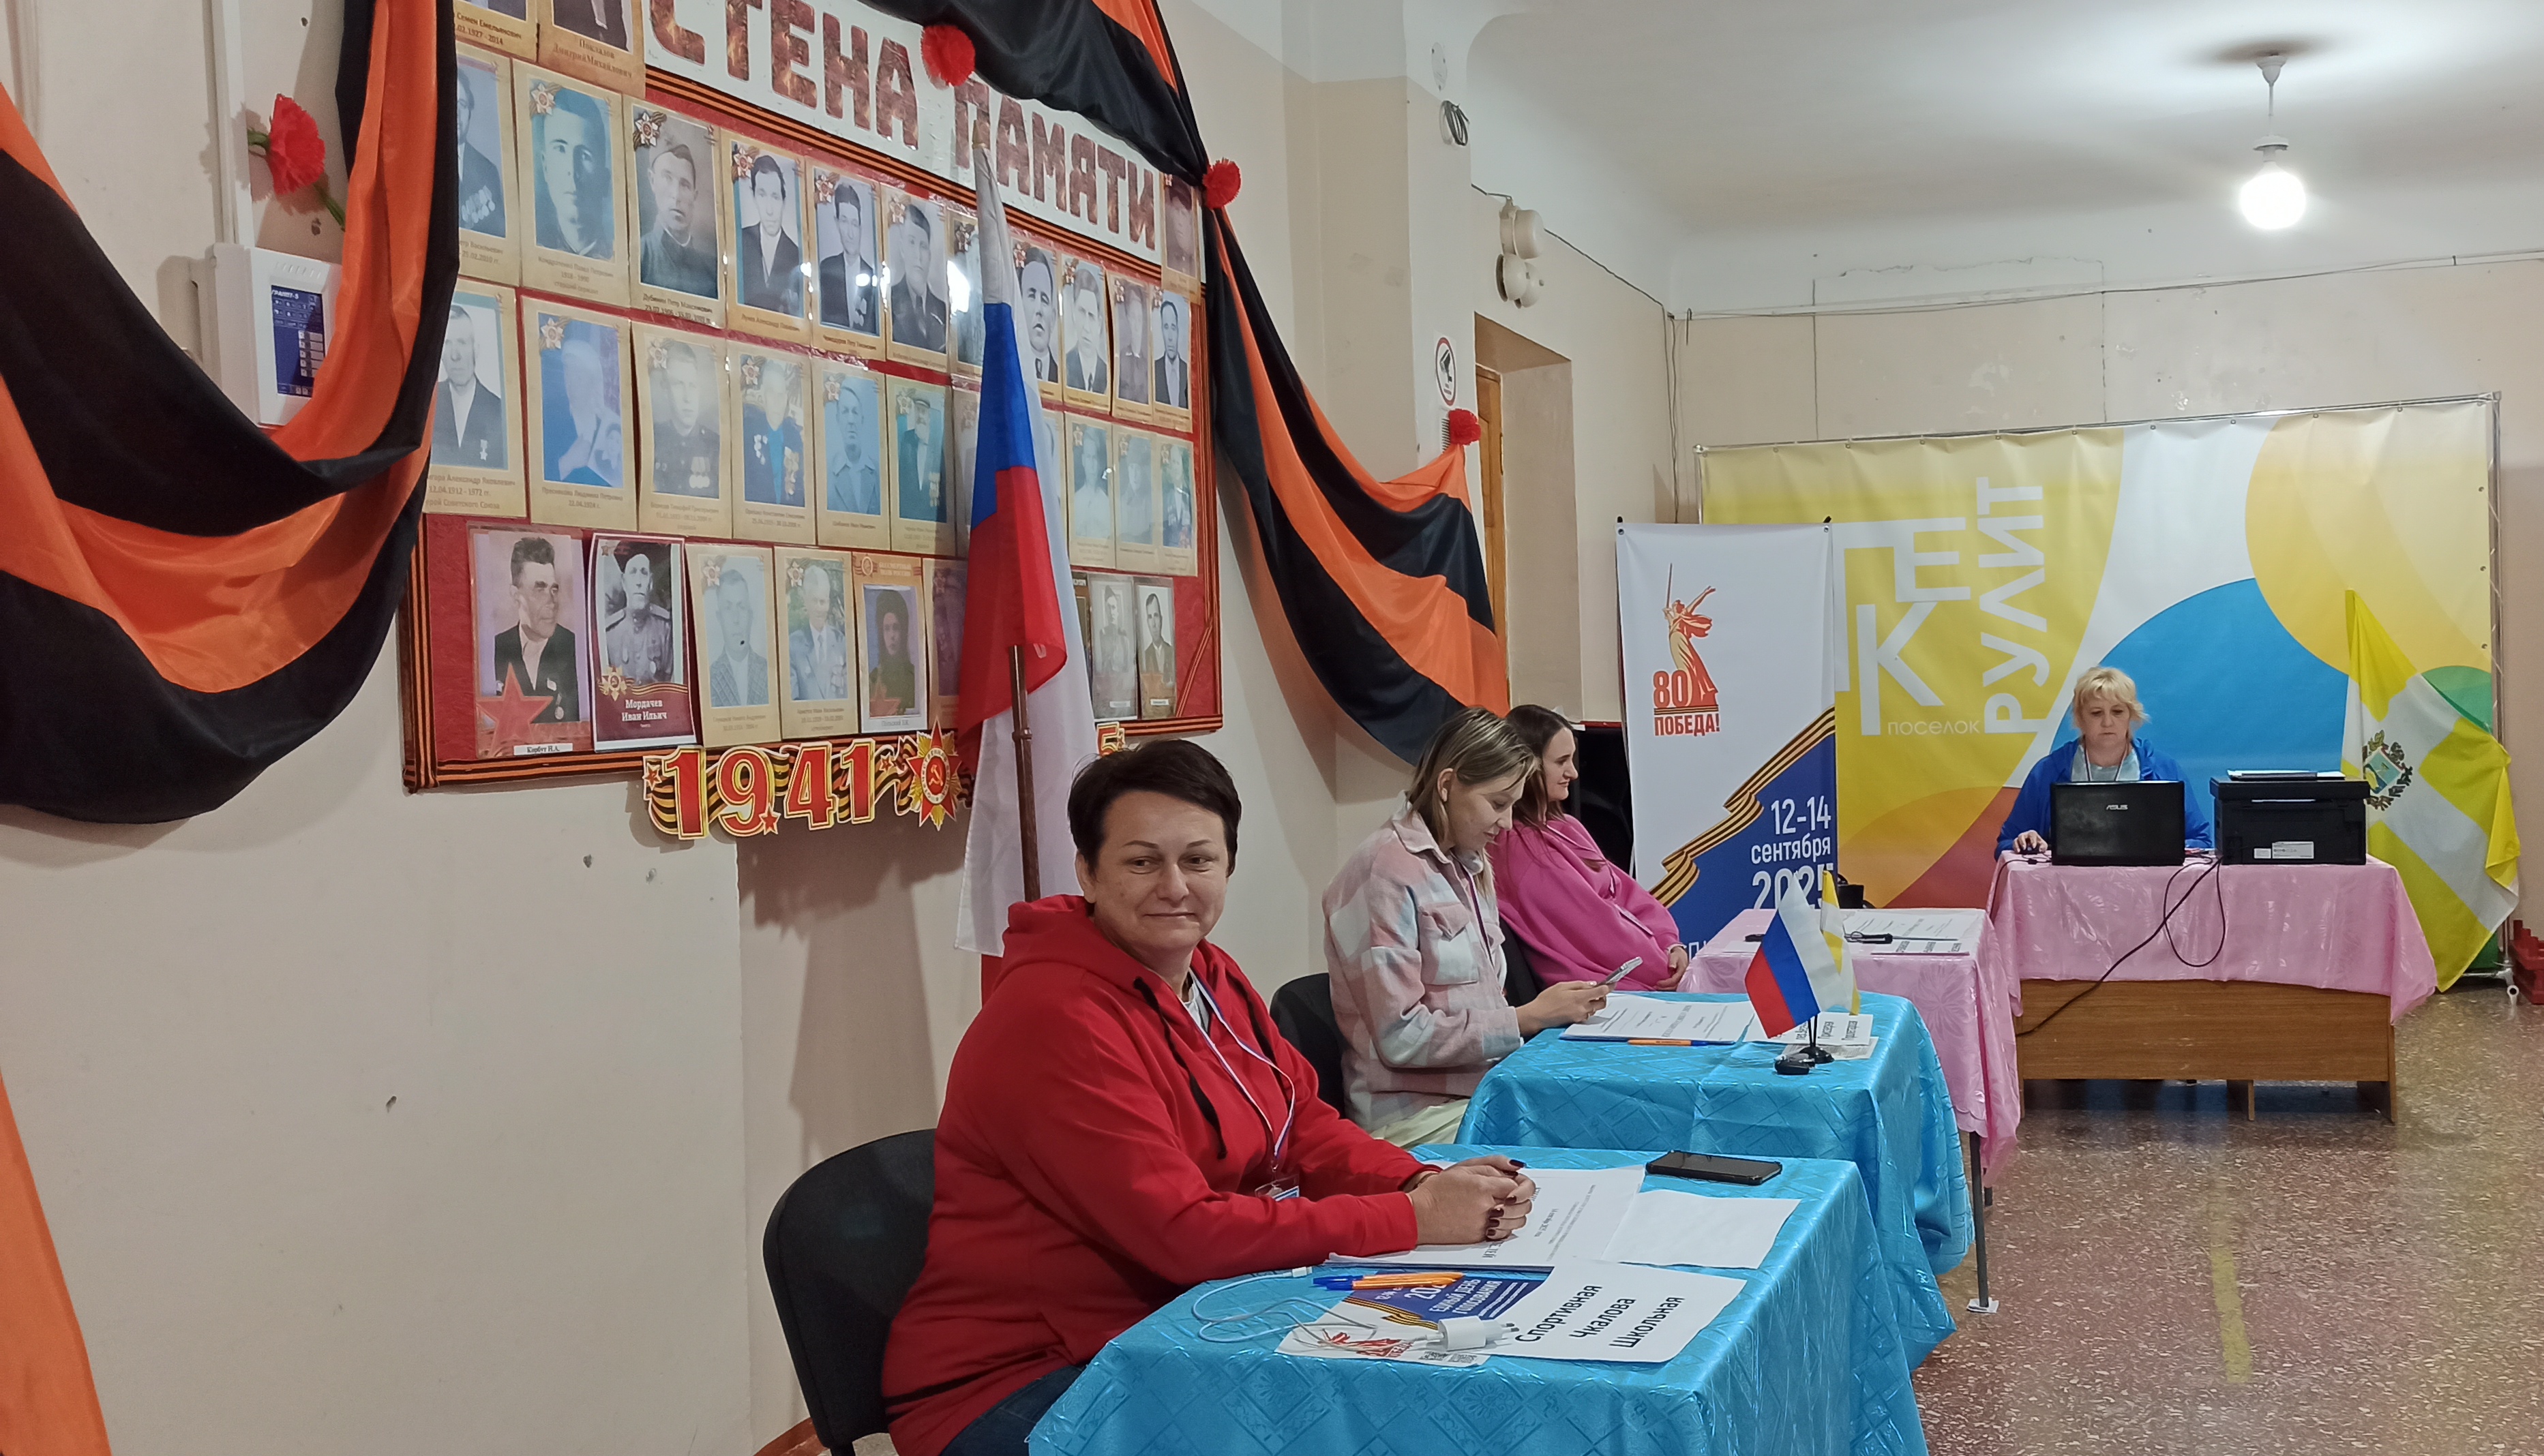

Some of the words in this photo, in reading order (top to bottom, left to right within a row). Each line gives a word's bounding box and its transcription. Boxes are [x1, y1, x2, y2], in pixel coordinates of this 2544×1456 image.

[456, 25, 483, 39] .02.1927
[649, 0, 919, 151] СТЕНА
[955, 77, 1155, 251] ПАМЯТИ
[1976, 476, 2050, 734] РУЛИТ
[625, 699, 663, 710] Мордачев
[1653, 669, 1689, 709] 80
[622, 712, 642, 723] Иван
[643, 711, 667, 722] Ильич
[1654, 713, 1720, 736] ПОБЕДА!
[661, 738, 876, 840] 1941
[1771, 795, 1831, 834] 12-14
[1751, 832, 1831, 864] сентября
[1514, 1285, 1602, 1343] Спортивная
[1568, 1298, 1636, 1339] Чкалова
[1608, 1296, 1686, 1348] Школьная
